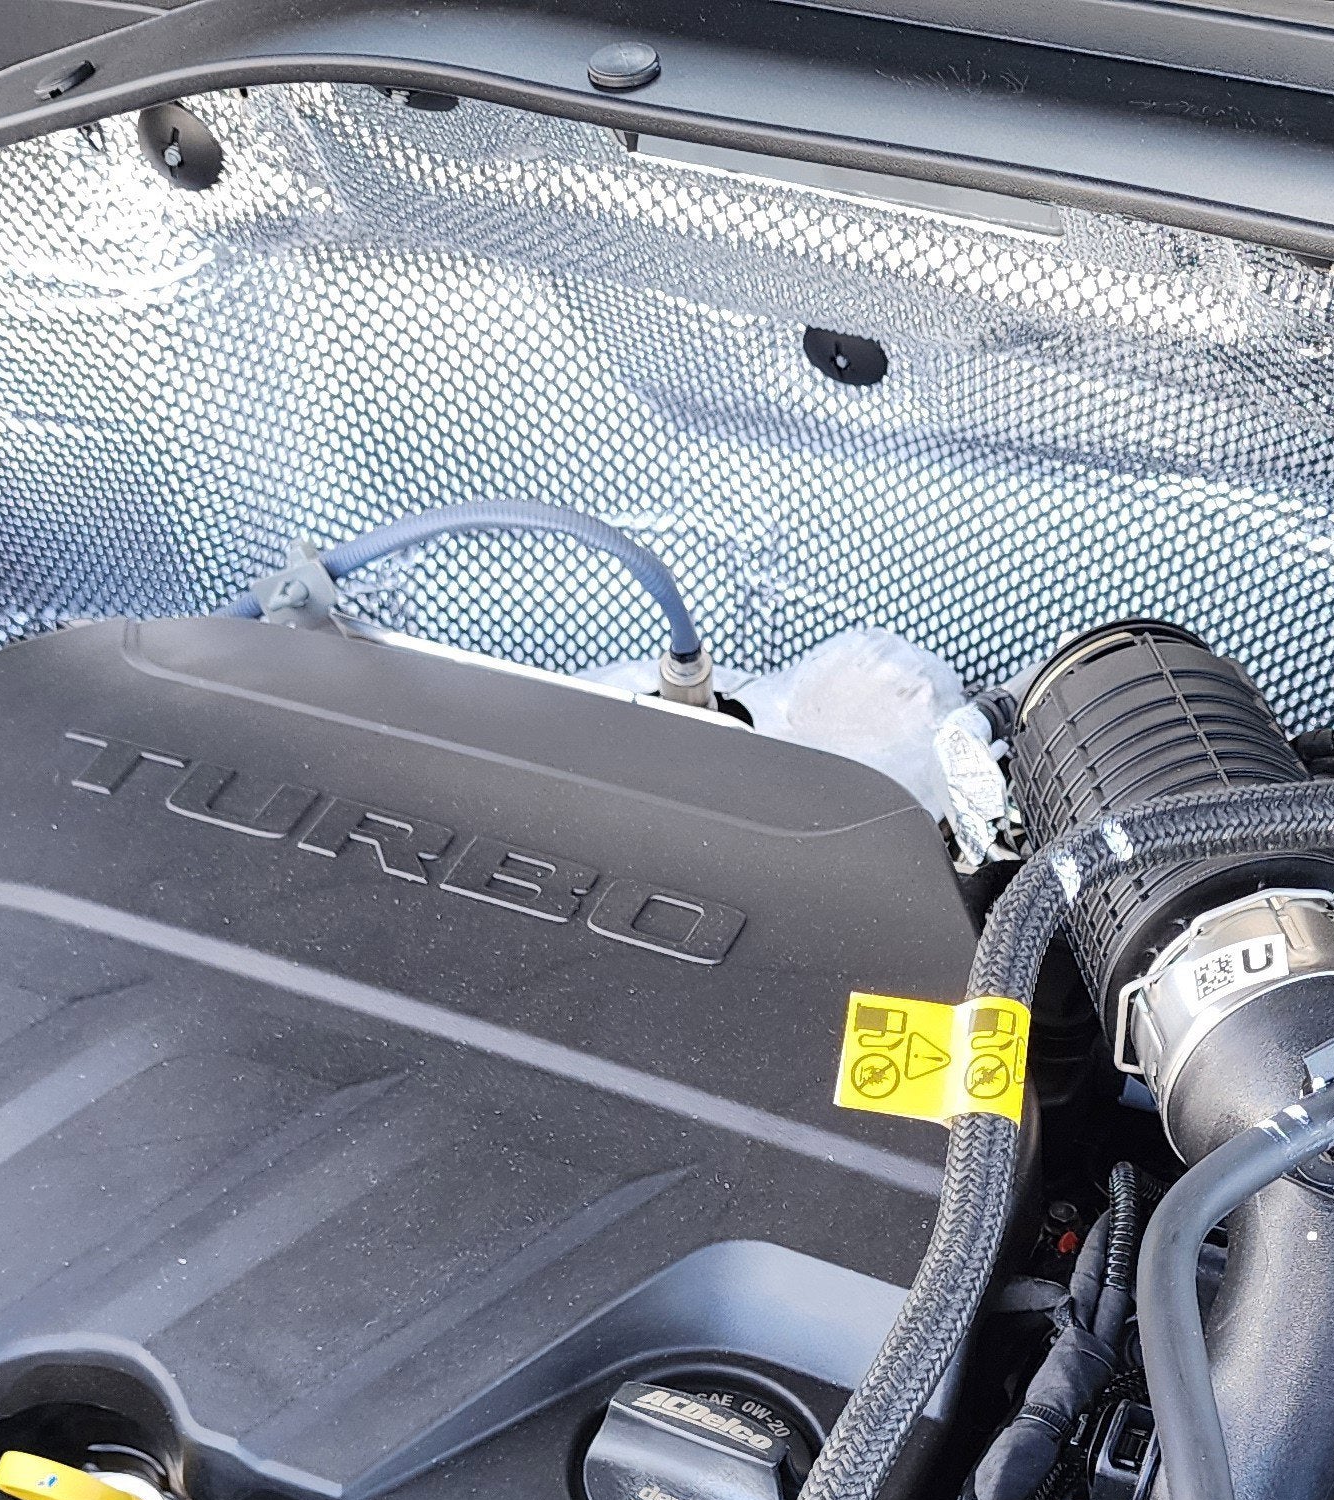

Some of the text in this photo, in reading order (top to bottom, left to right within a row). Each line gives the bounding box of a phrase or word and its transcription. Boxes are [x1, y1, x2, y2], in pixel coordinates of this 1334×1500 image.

[64, 730, 749, 967] TURBO
[1240, 943, 1274, 974] U
[631, 1390, 774, 1453] ACDelco
[741, 1399, 792, 1438] 0W-20
